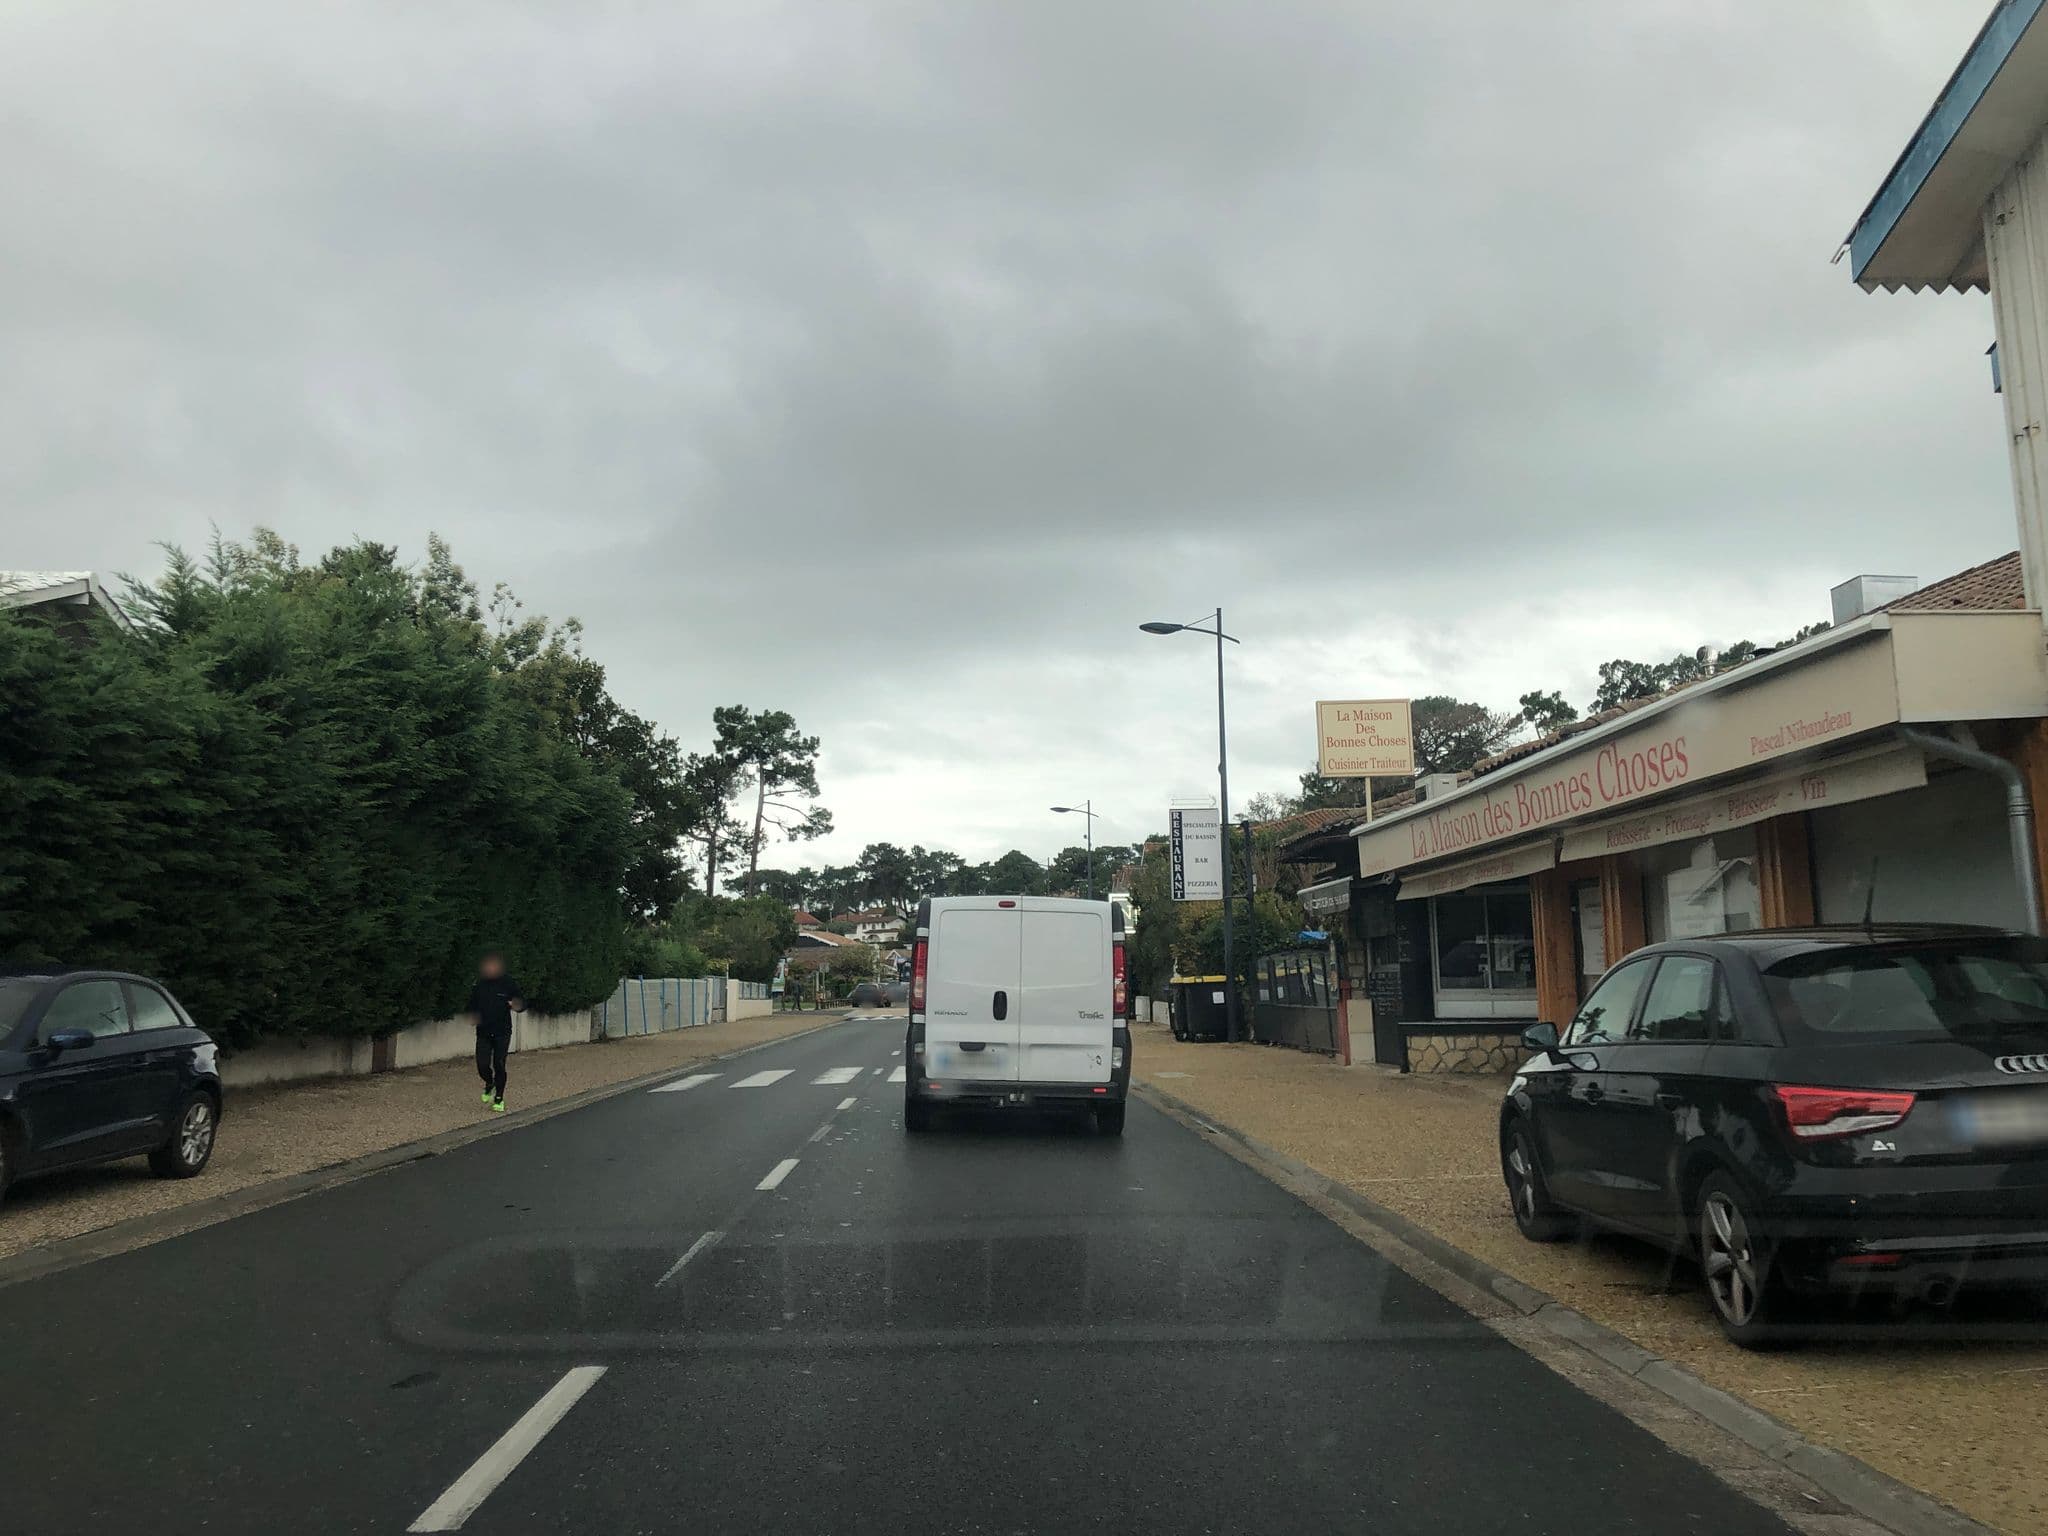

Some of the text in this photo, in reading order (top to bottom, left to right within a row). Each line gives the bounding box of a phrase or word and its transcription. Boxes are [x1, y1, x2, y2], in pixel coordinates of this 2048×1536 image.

[1337, 708, 1392, 721] La Maison
[1355, 723, 1376, 734] Des
[1327, 735, 1407, 748] Bonnes Choses
[1751, 727, 1784, 755] Pascal
[1328, 757, 1407, 770] Cuisinier Traiteur
[1801, 776, 1827, 801] Vin
[1409, 736, 1689, 860] La Maison des Bonnes Choses
[1172, 812, 1184, 899] RESTAURANT
[1871, 1140, 1896, 1151] A1
